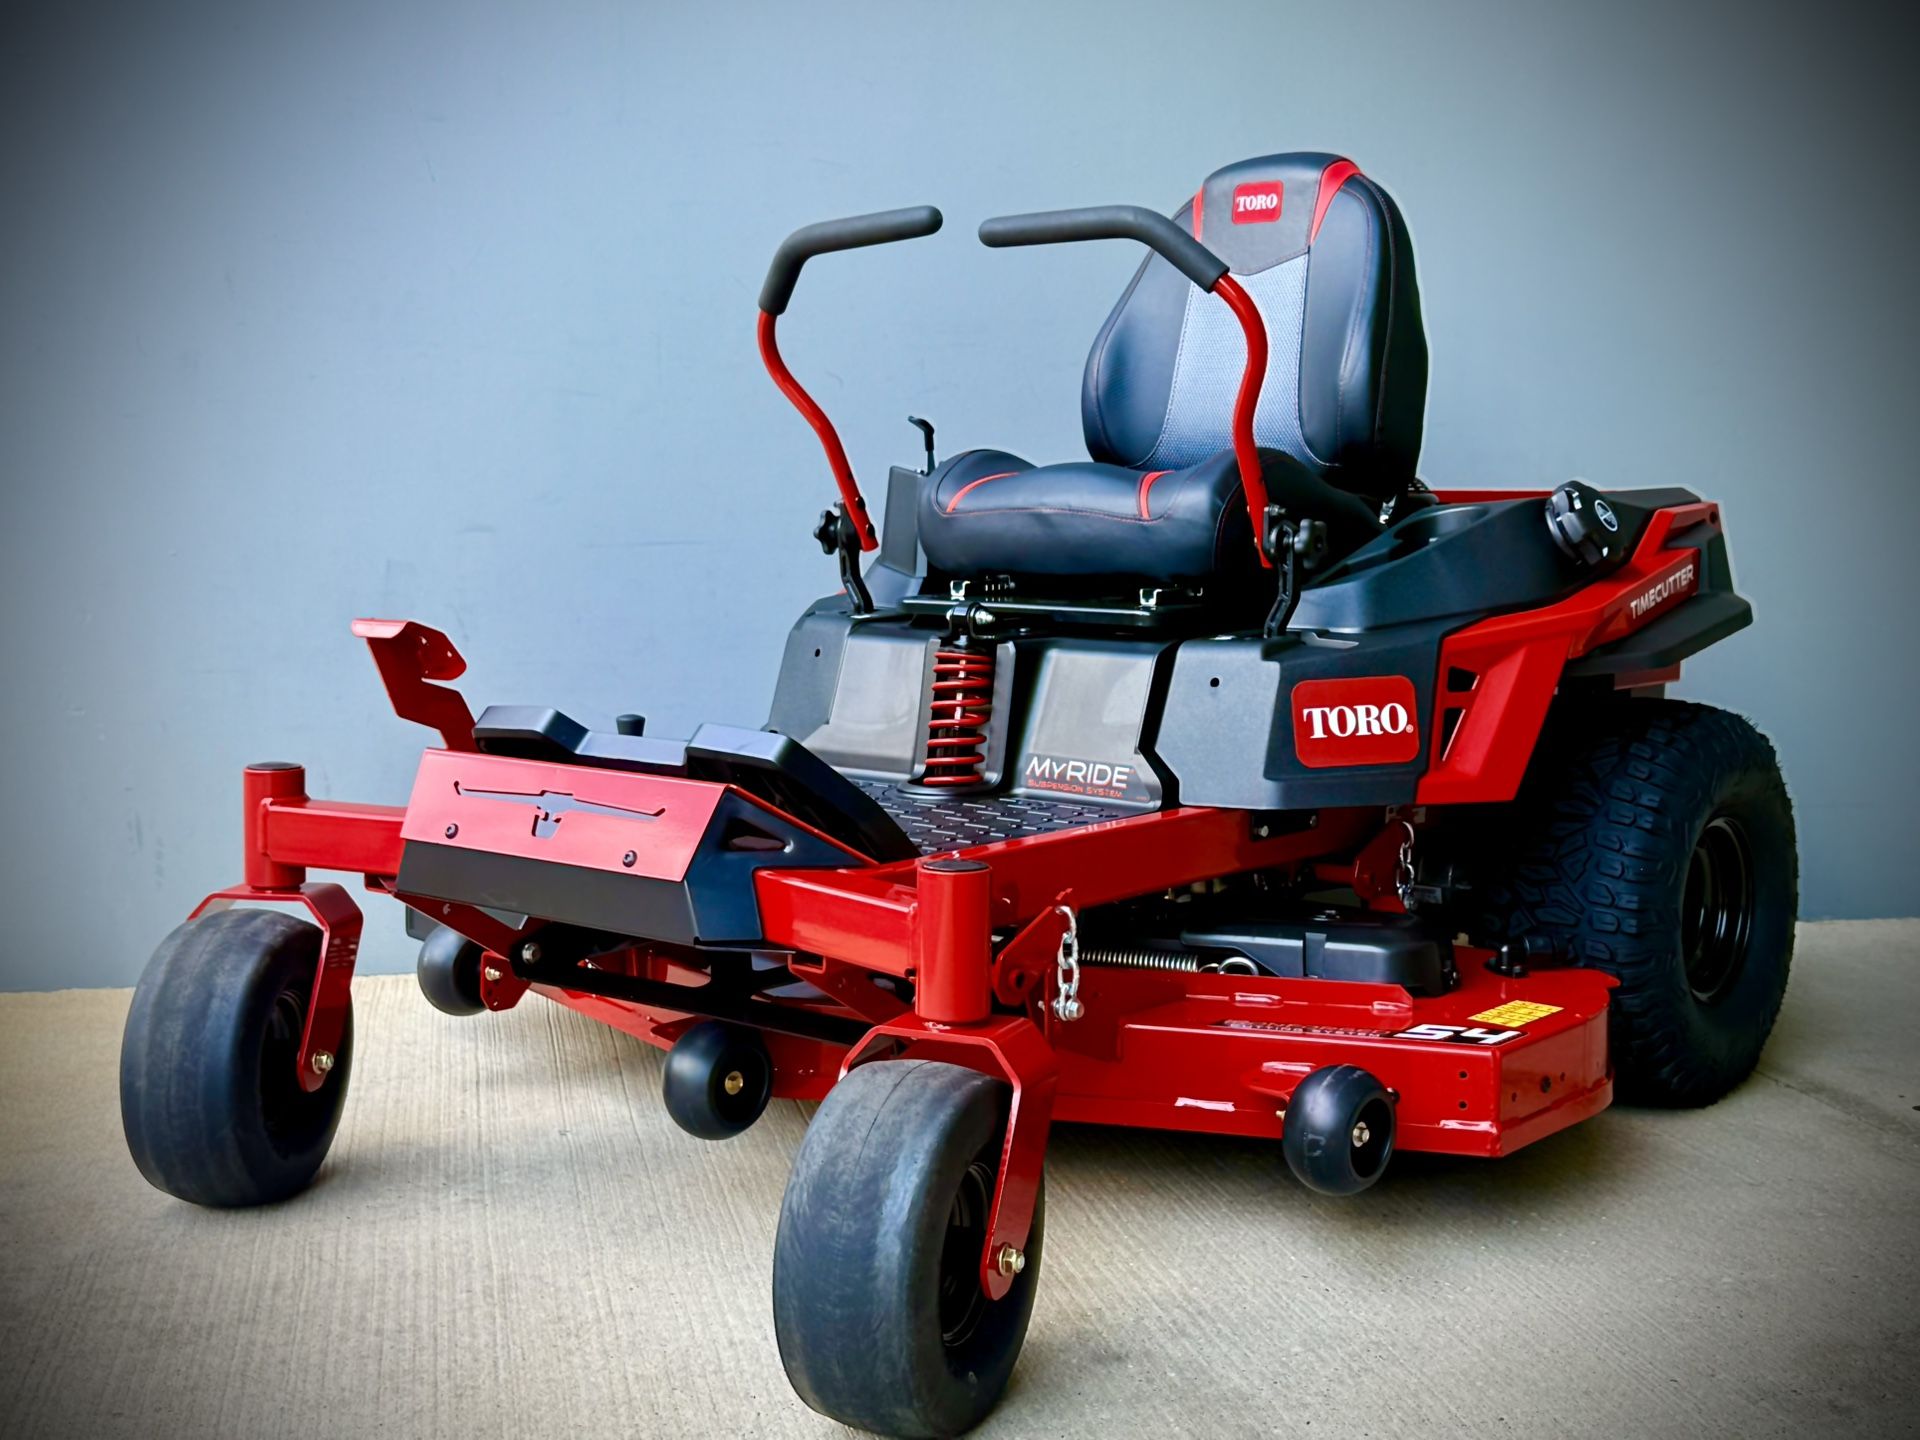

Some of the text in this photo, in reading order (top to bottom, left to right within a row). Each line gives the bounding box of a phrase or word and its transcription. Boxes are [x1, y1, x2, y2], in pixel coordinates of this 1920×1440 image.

[1236, 193, 1278, 212] TORO
[1630, 564, 1694, 619] TIMECUTTER
[1303, 703, 1408, 739] TORO
[1027, 779, 1083, 793] SUSPENSION
[1393, 1023, 1522, 1044] 54
